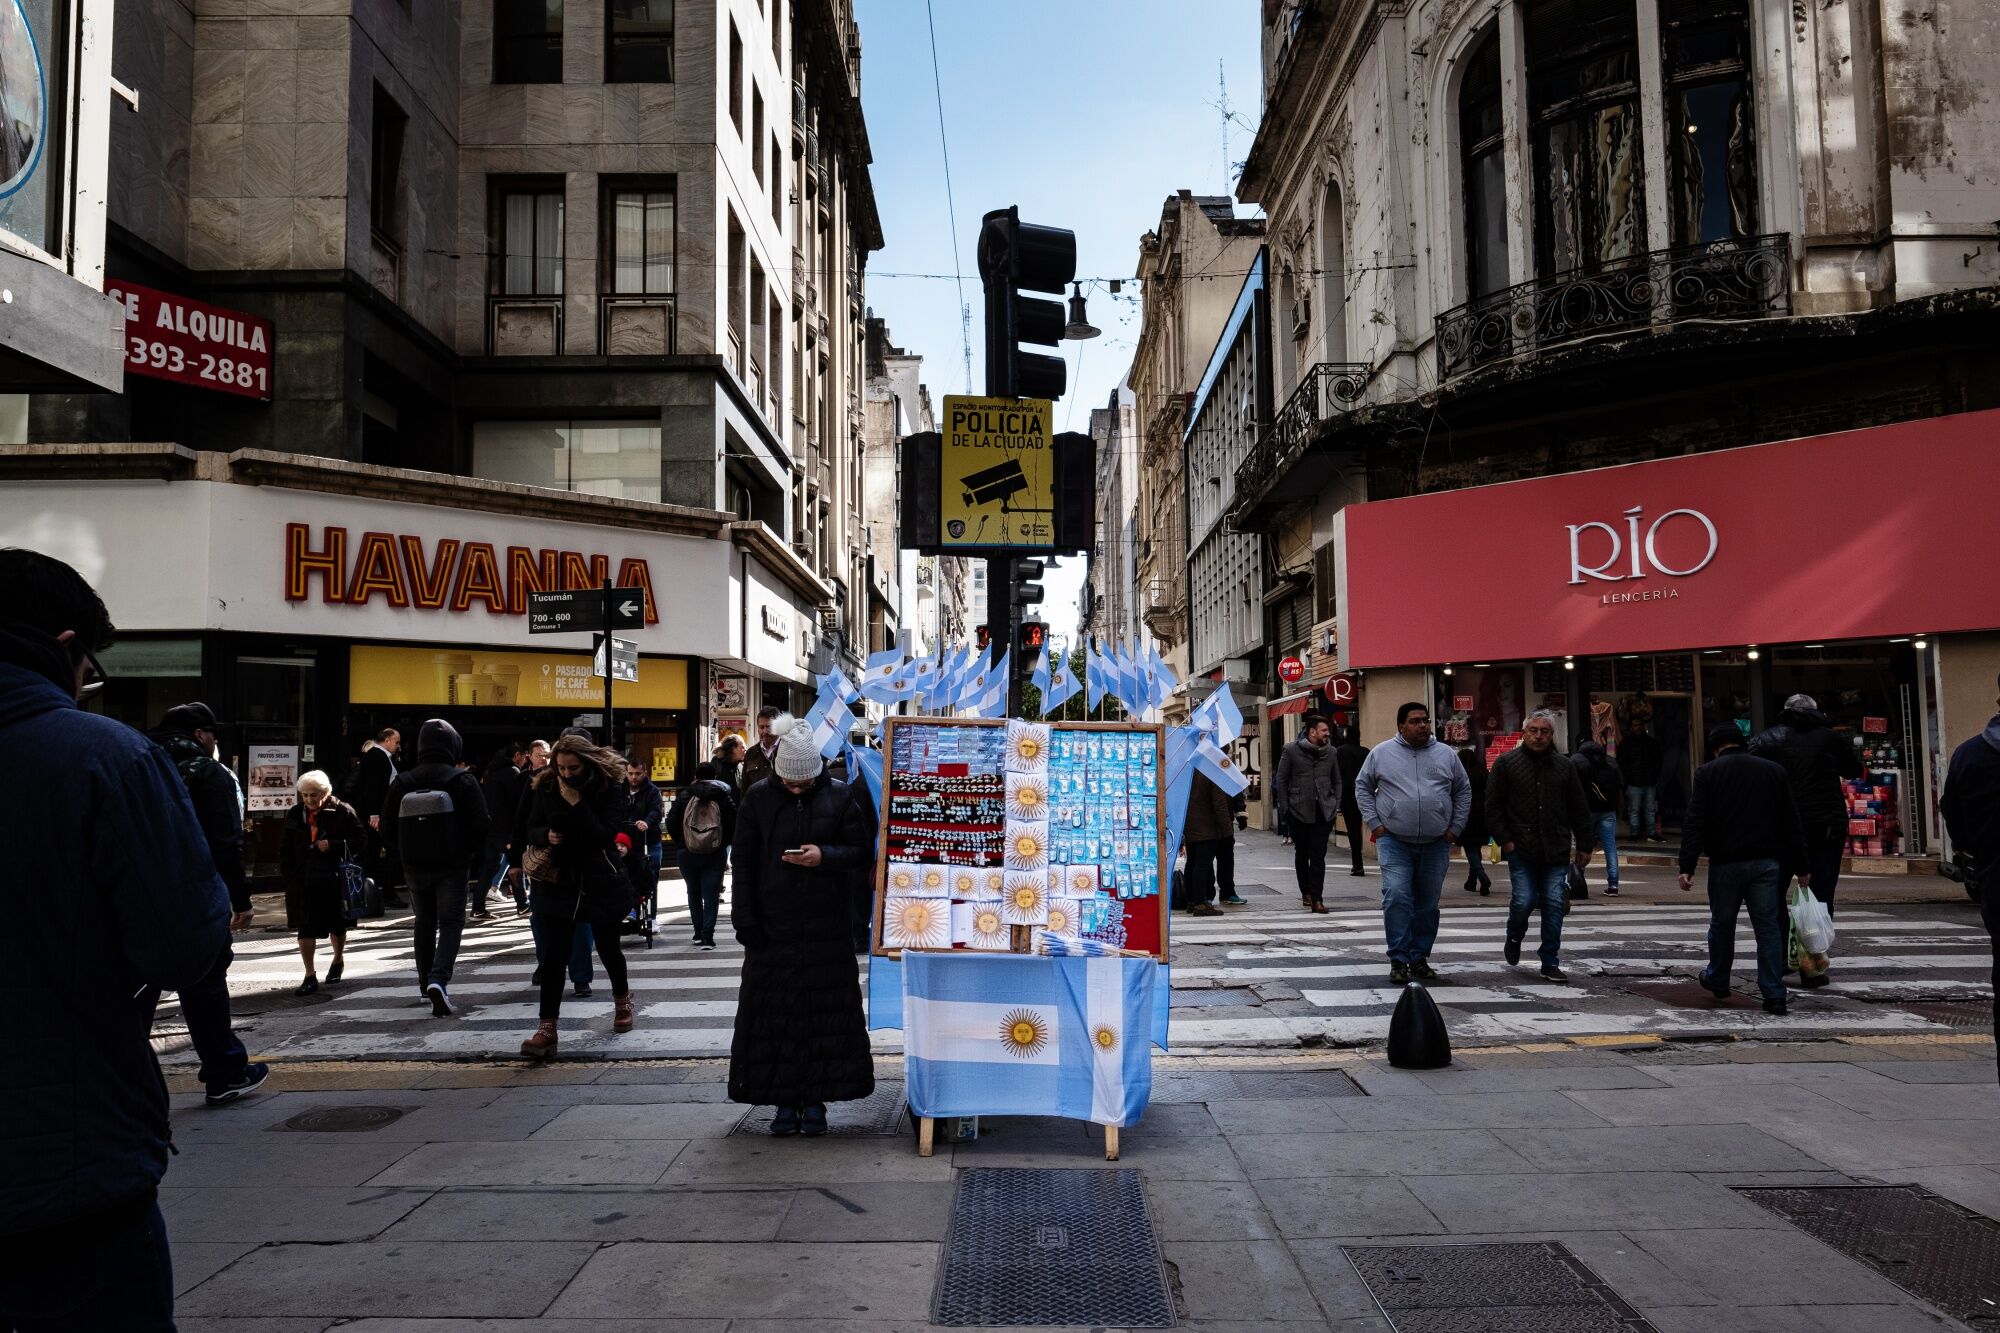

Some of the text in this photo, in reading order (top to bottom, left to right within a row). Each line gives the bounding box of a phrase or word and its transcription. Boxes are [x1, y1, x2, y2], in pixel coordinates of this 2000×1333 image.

[156, 302, 267, 353] ALQUILA
[124, 337, 267, 391] 393-2881
[953, 411, 1042, 435] POLICIA
[952, 434, 1043, 449] DE LA CIUDAD
[1565, 505, 1719, 584] RÍO
[285, 523, 659, 624] HAVANNA
[532, 592, 572, 602] Tucumán
[533, 614, 548, 622] 700
[555, 613, 571, 621] 600
[556, 665, 593, 676] PASEADO
[556, 677, 567, 688] DE
[568, 675, 588, 689] CAFÉ
[556, 688, 603, 700] HAVANNA
[1246, 774, 1260, 786] FF
